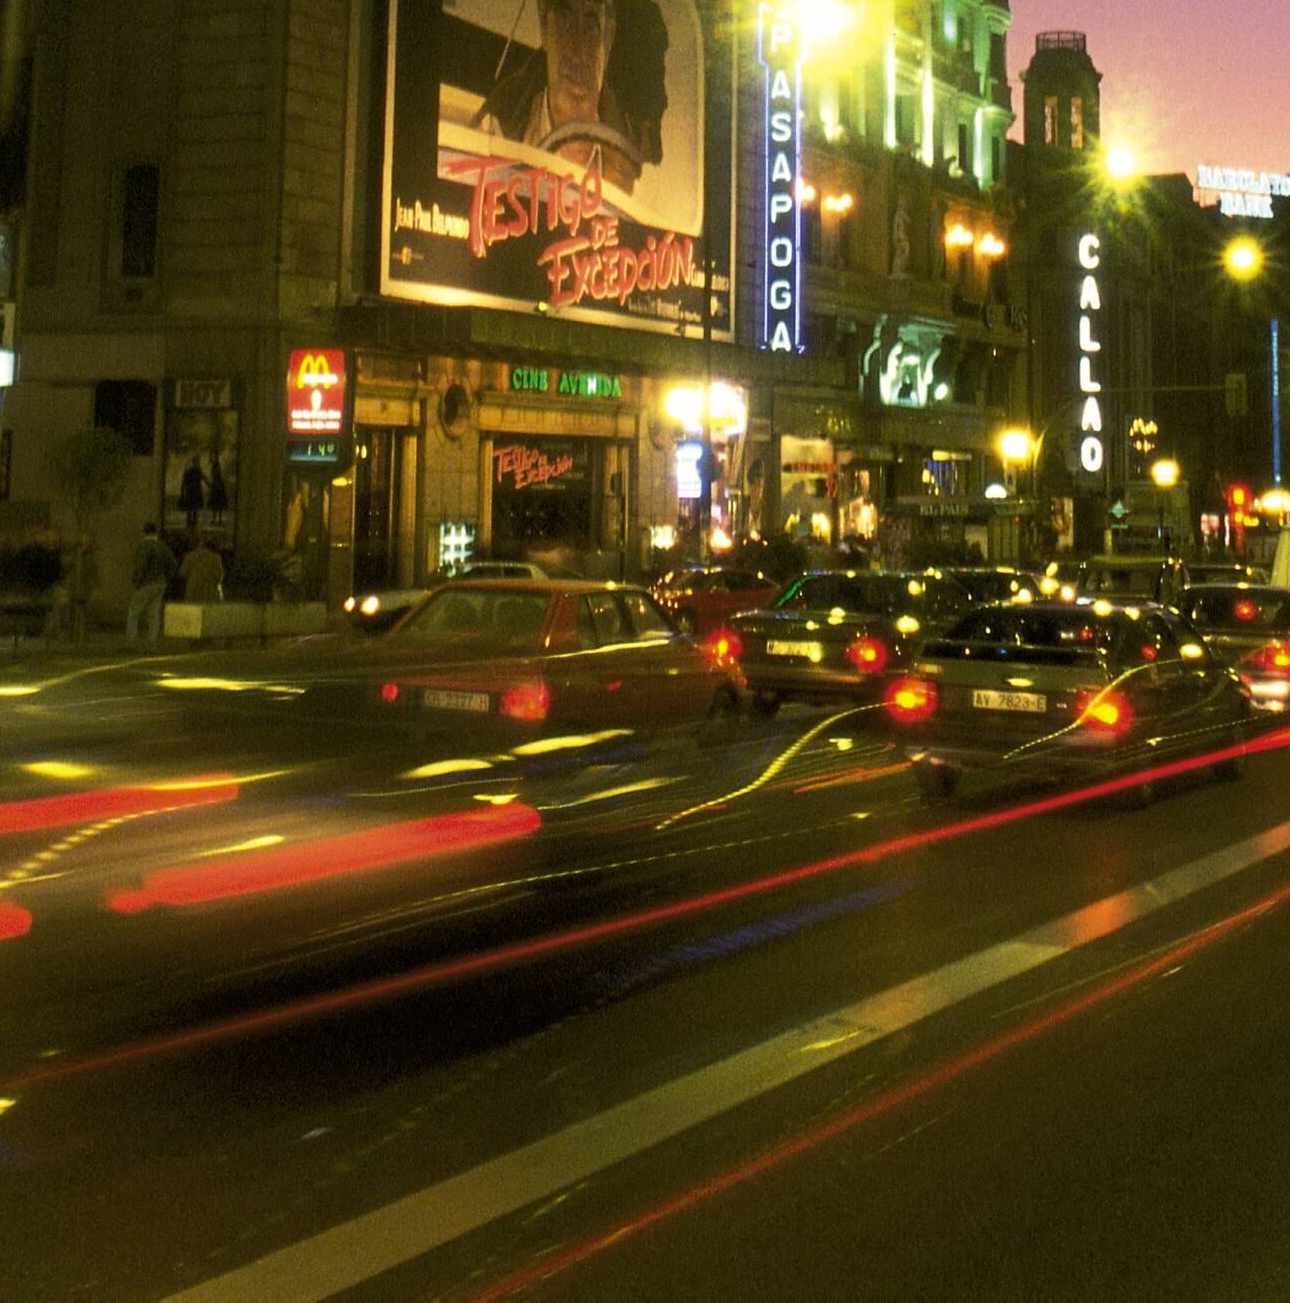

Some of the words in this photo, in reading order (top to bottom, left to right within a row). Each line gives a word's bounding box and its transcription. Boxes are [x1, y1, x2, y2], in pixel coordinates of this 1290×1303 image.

[443, 155, 605, 260] TESTIGO
[769, 23, 794, 352] PASAPOGA
[1218, 191, 1274, 218] BANK
[590, 215, 620, 251] DE
[512, 366, 549, 392] CINE
[559, 371, 622, 398] AVENIDA
[1078, 233, 1103, 473] CALLAO
